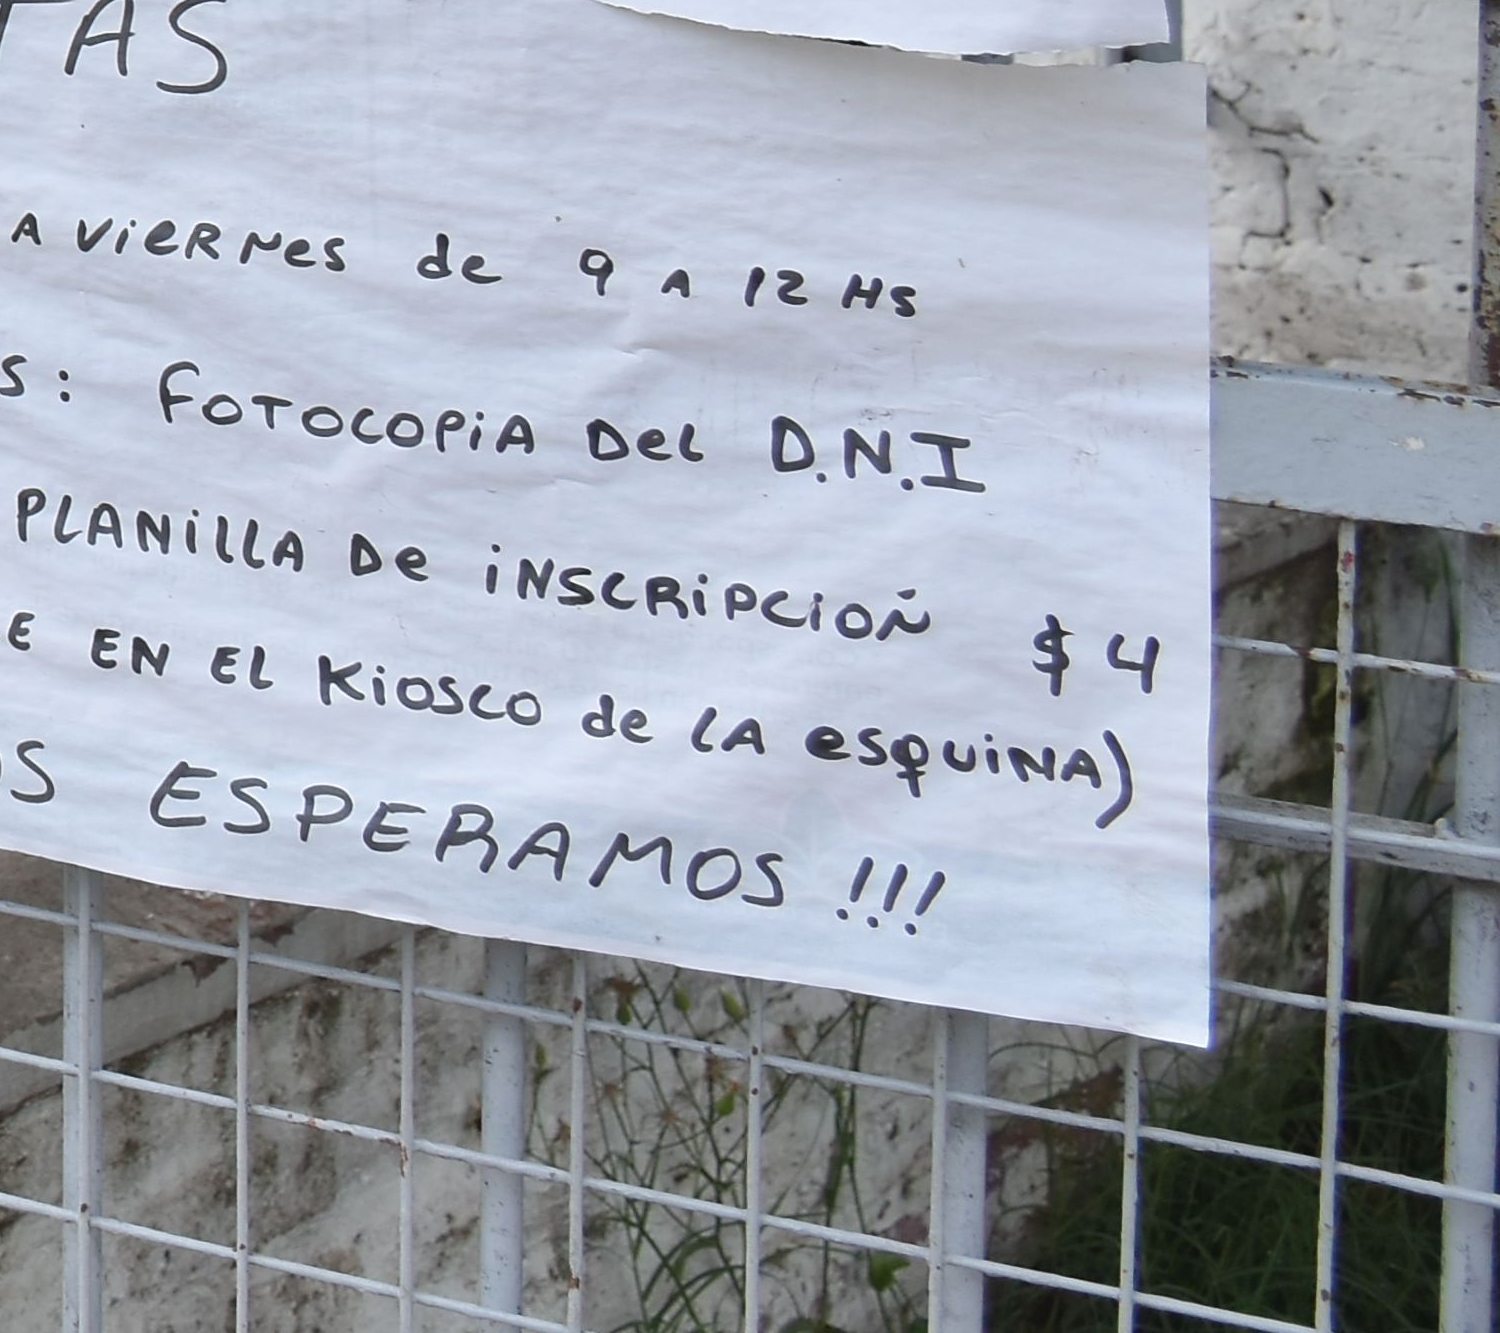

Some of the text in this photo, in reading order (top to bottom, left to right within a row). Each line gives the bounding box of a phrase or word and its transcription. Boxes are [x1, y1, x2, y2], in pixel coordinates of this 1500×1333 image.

[9, 211, 43, 247] A
[415, 231, 504, 286] de
[578, 247, 615, 298] 9
[659, 268, 692, 300] A
[743, 265, 810, 309] 12
[89, 627, 171, 678] EN
[209, 644, 275, 691] EL
[580, 693, 655, 745] de
[690, 706, 767, 756] LA
[148, 760, 785, 909] ESPERAMOS
